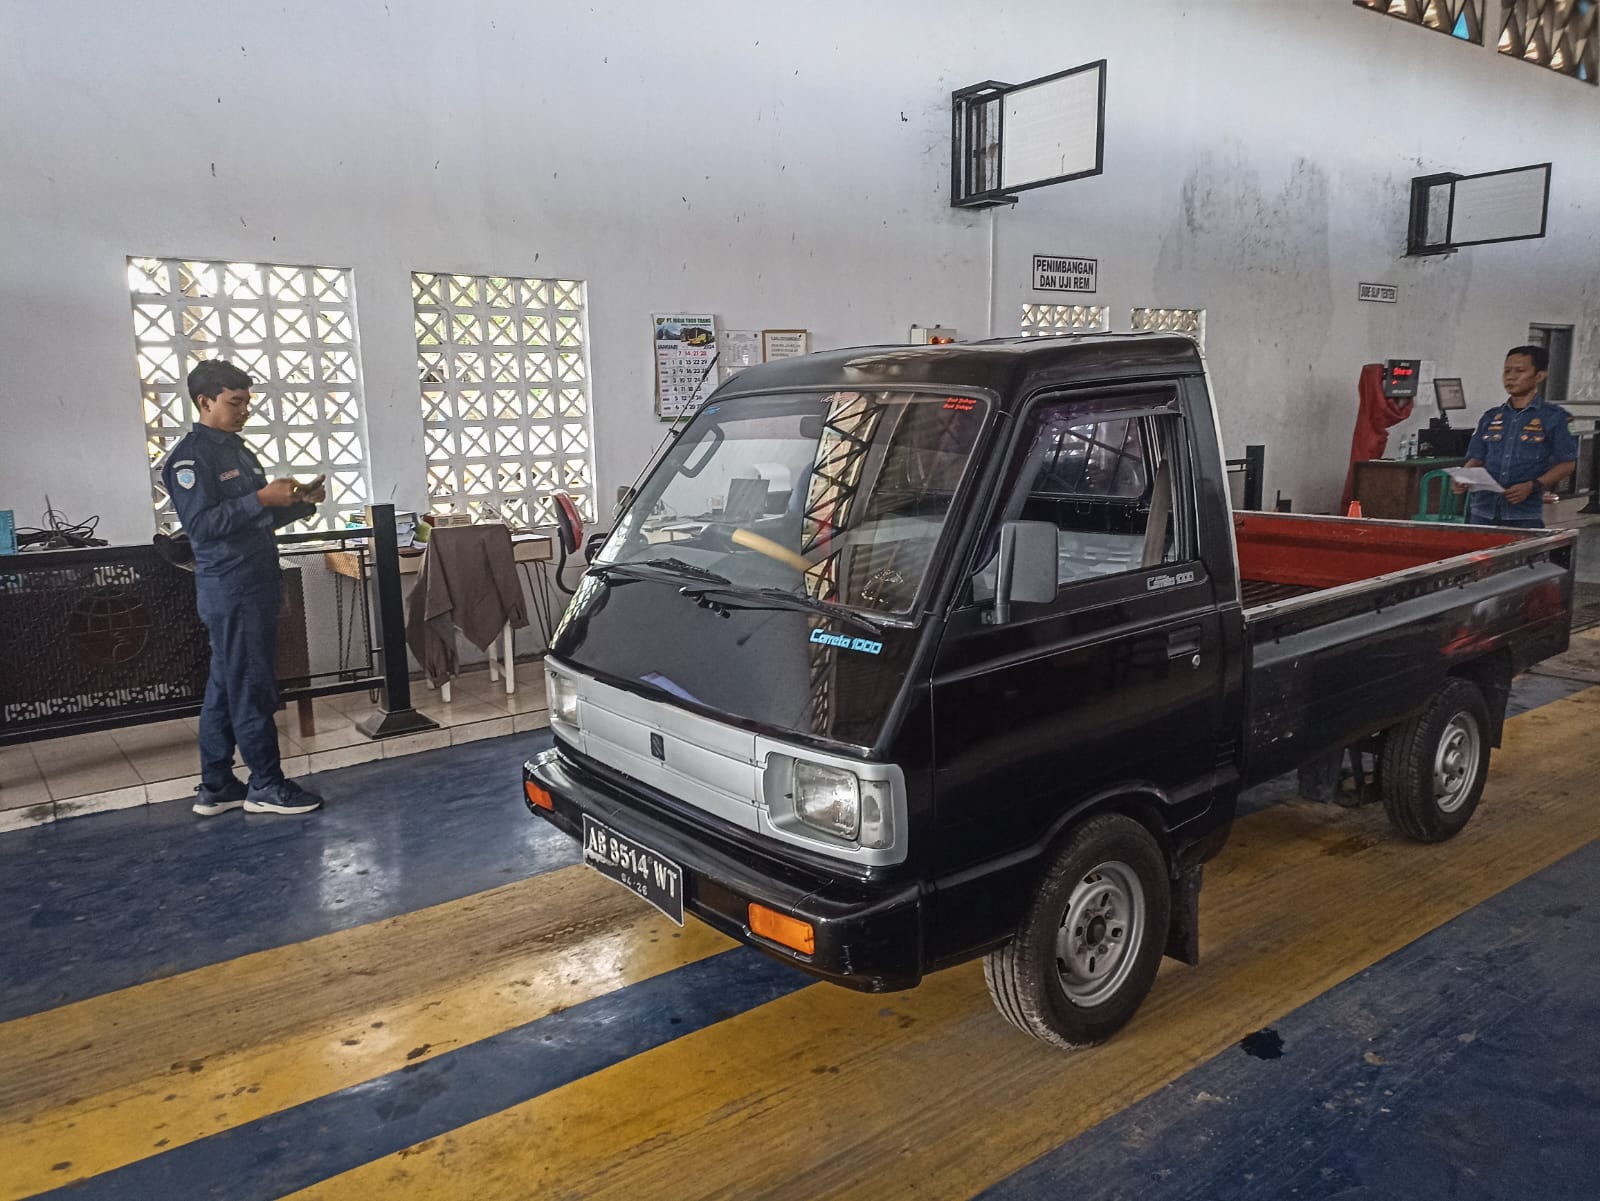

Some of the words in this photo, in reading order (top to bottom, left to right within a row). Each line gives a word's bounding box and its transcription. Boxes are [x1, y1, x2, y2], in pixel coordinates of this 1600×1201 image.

[1036, 259, 1094, 275] PENIMBANGAN
[1040, 275, 1057, 288] DAN
[1058, 276, 1072, 289] UJI
[1073, 277, 1090, 289] REM
[851, 638, 883, 655] 1000
[589, 826, 607, 856] AB
[609, 837, 650, 879] 8514
[653, 860, 678, 898] WT
